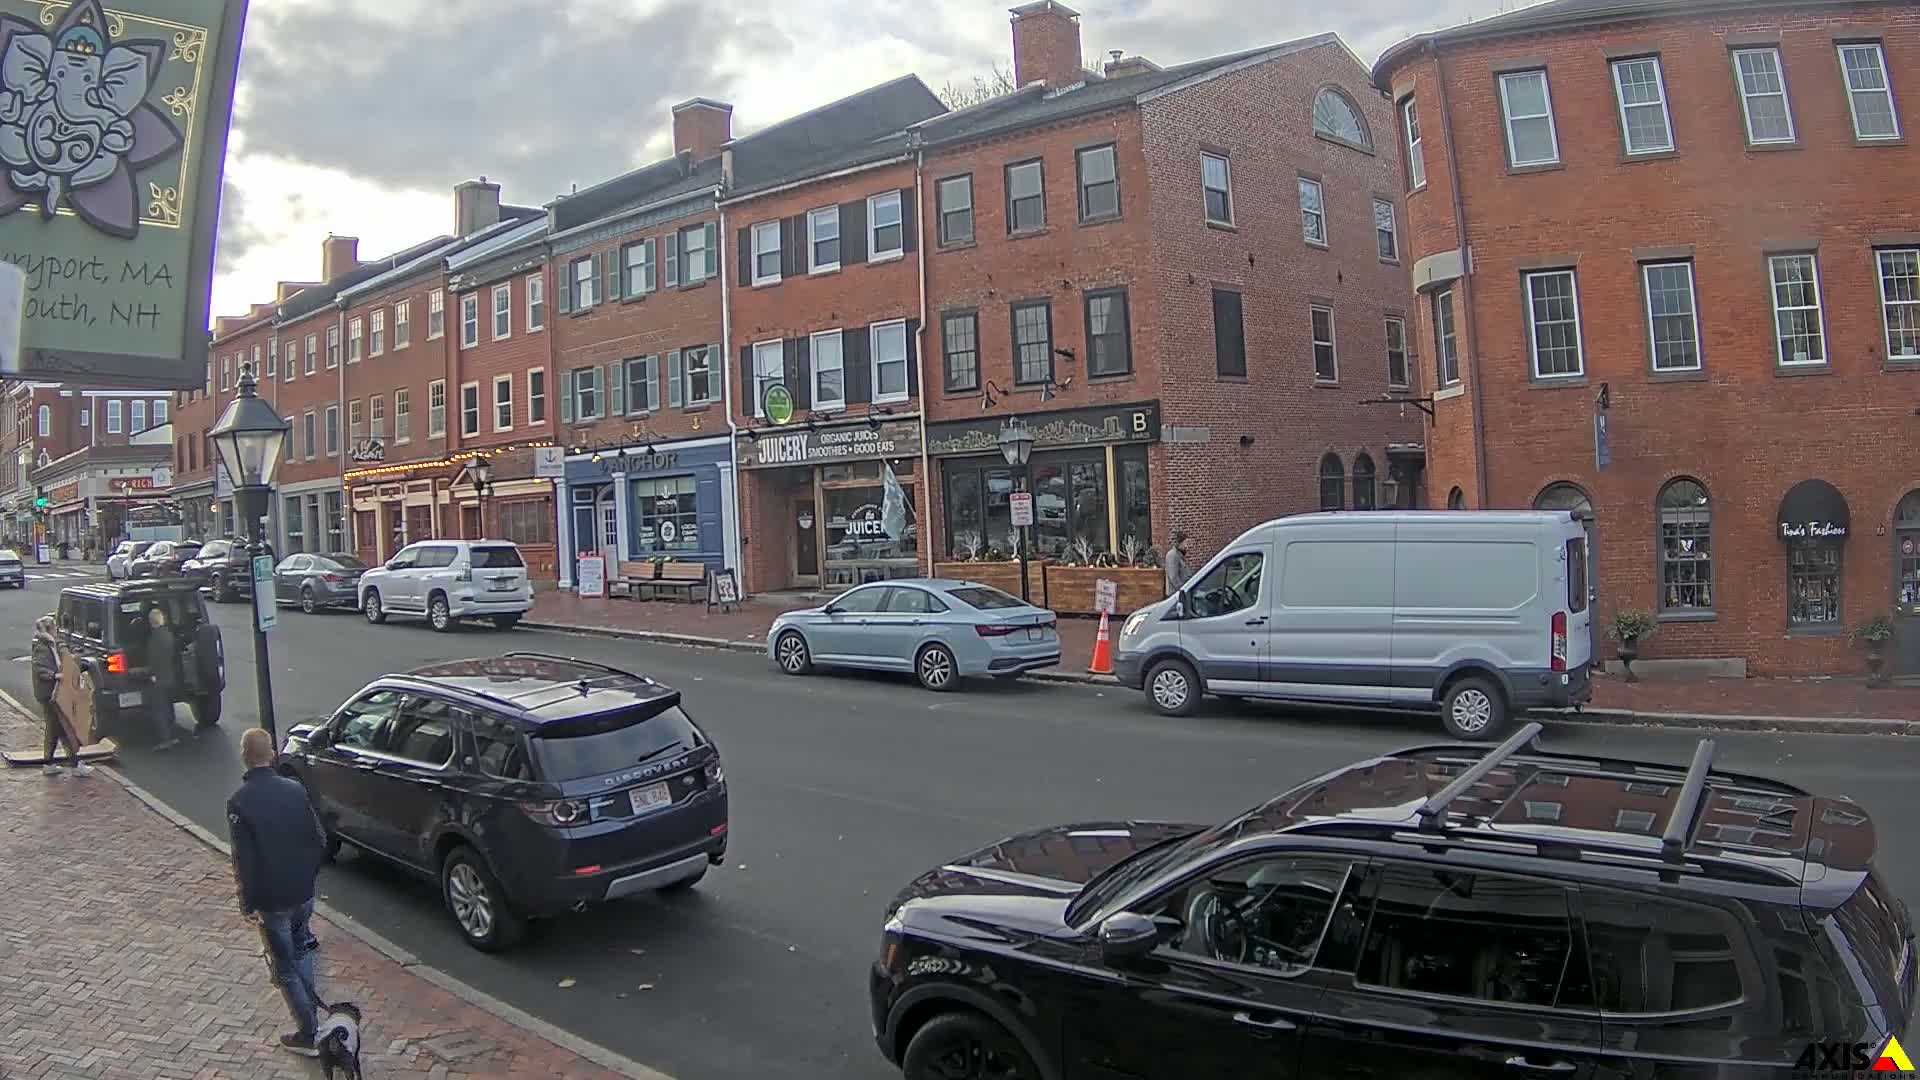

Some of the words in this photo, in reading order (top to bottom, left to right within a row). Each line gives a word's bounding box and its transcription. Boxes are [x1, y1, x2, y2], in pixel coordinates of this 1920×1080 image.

[120, 260, 173, 288] MA
[110, 301, 161, 329] NH
[1133, 412, 1147, 432] B
[757, 434, 808, 463] JUICERY
[807, 445, 848, 458] SMOOTHIES
[853, 443, 876, 454] GOOD
[876, 441, 896, 453] EATS
[820, 431, 853, 444] ORGANIC
[607, 452, 679, 474] ANCHOR
[604, 758, 689, 785] DISCOVERY
